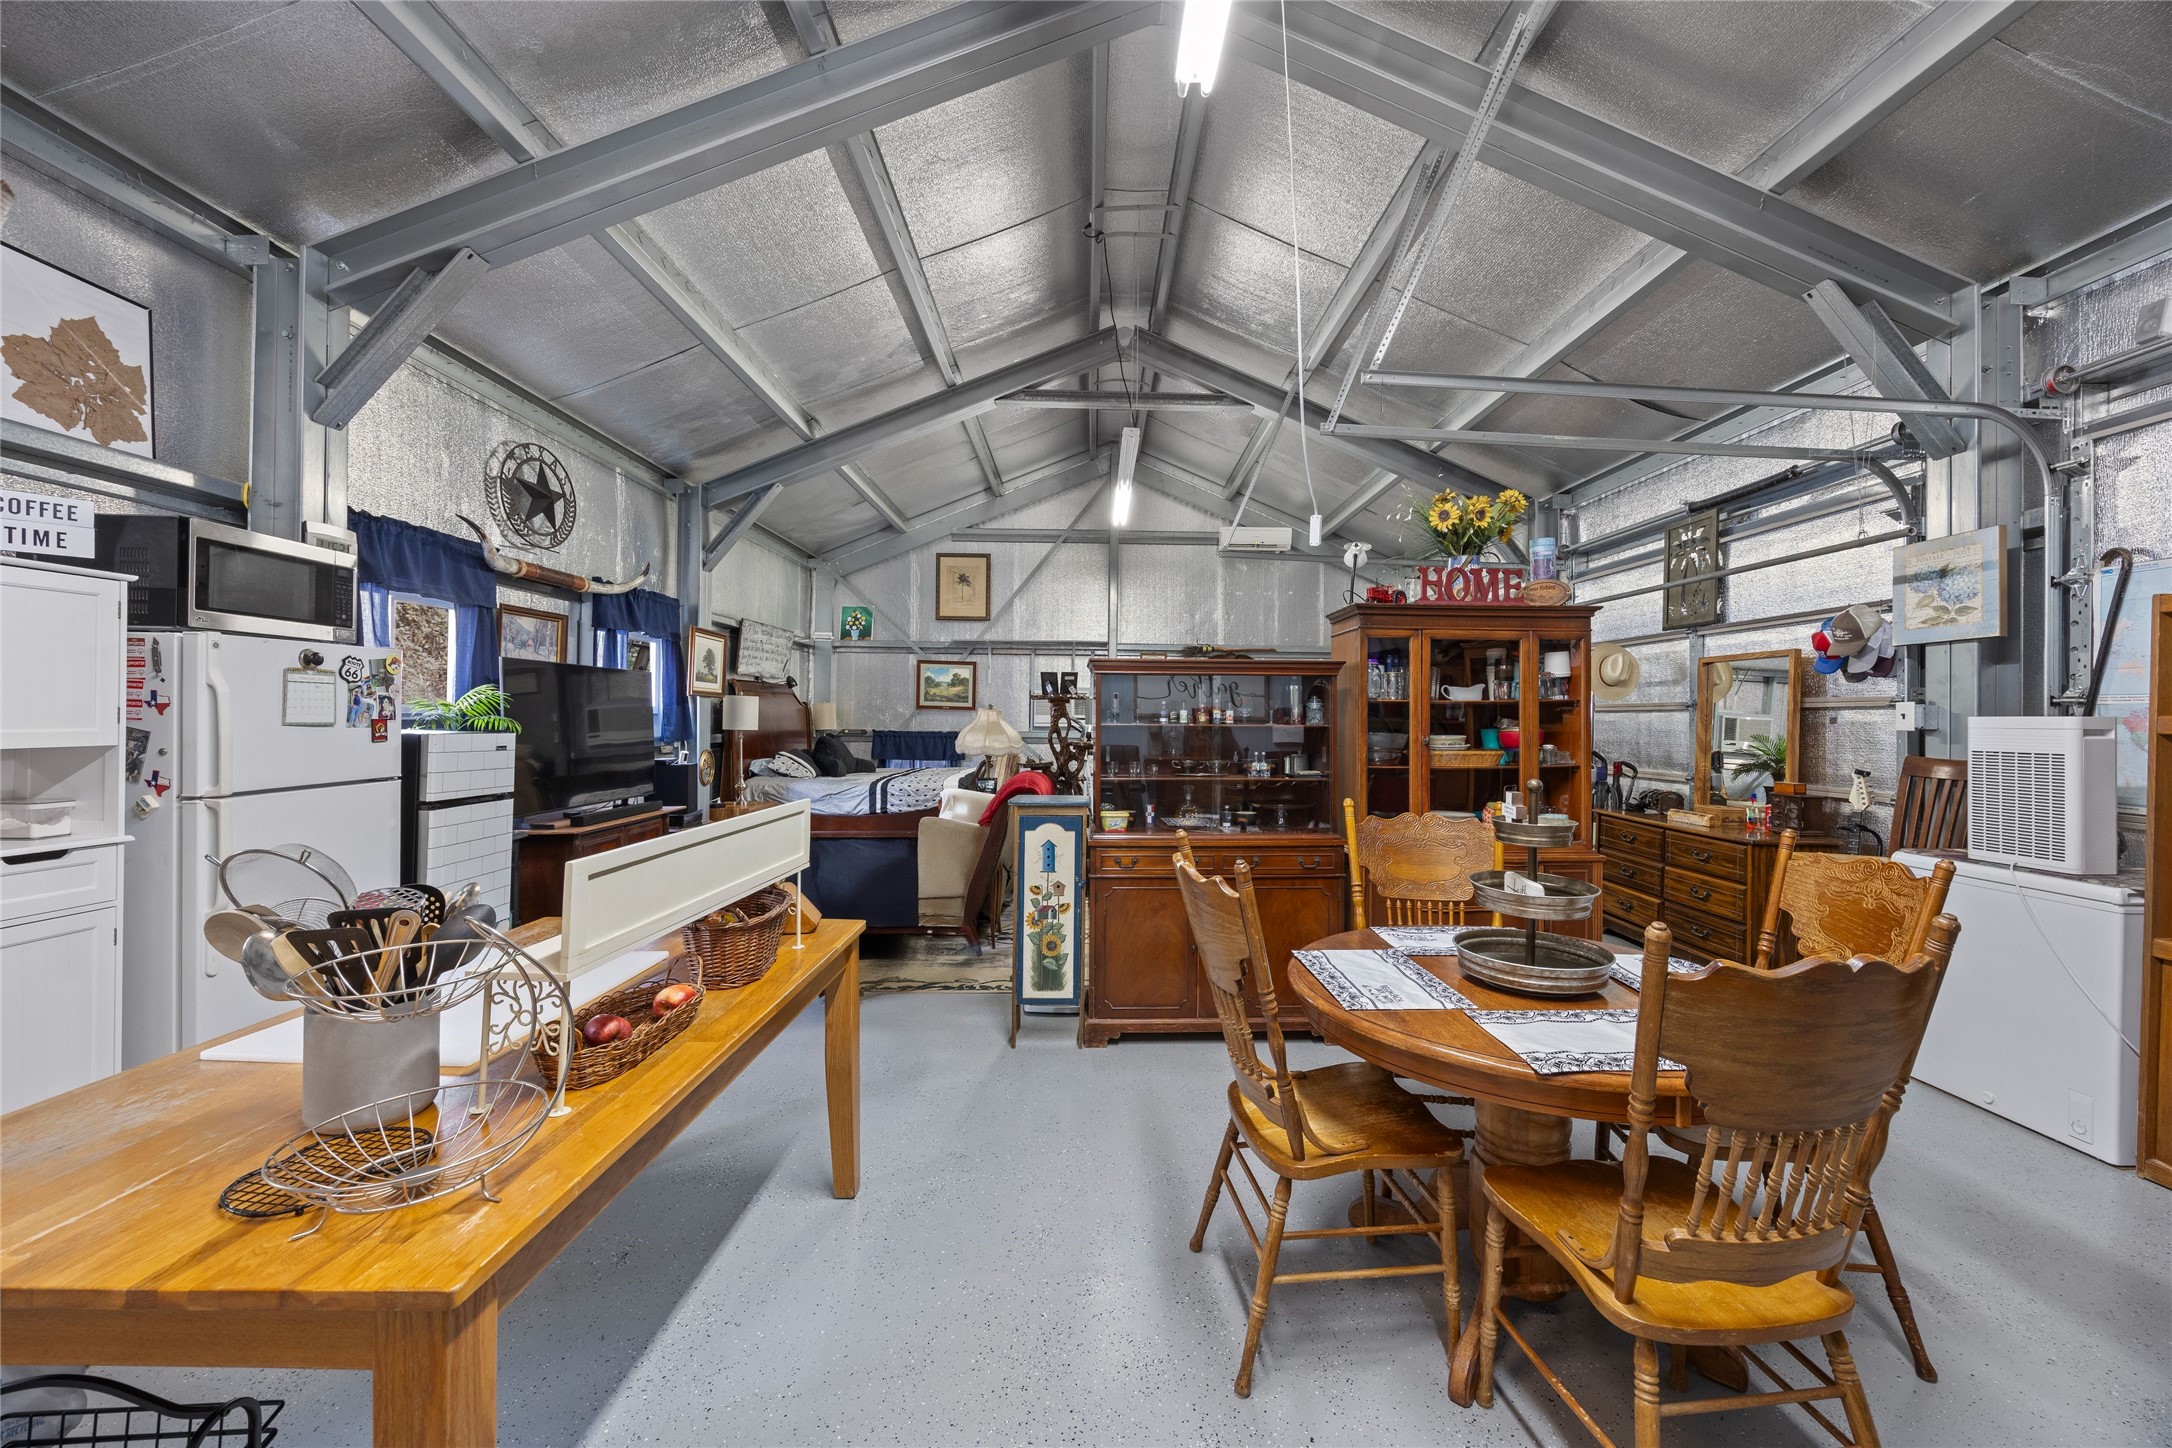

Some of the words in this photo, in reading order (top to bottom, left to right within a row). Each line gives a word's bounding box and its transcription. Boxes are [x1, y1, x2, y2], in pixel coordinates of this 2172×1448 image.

[507, 444, 569, 487] TEXAS
[4, 526, 67, 549] TIME
[1417, 566, 1523, 603] HOME
[344, 667, 359, 680] 66
[347, 659, 361, 667] ROUTE
[6, 1416, 45, 1438] RECYCING
